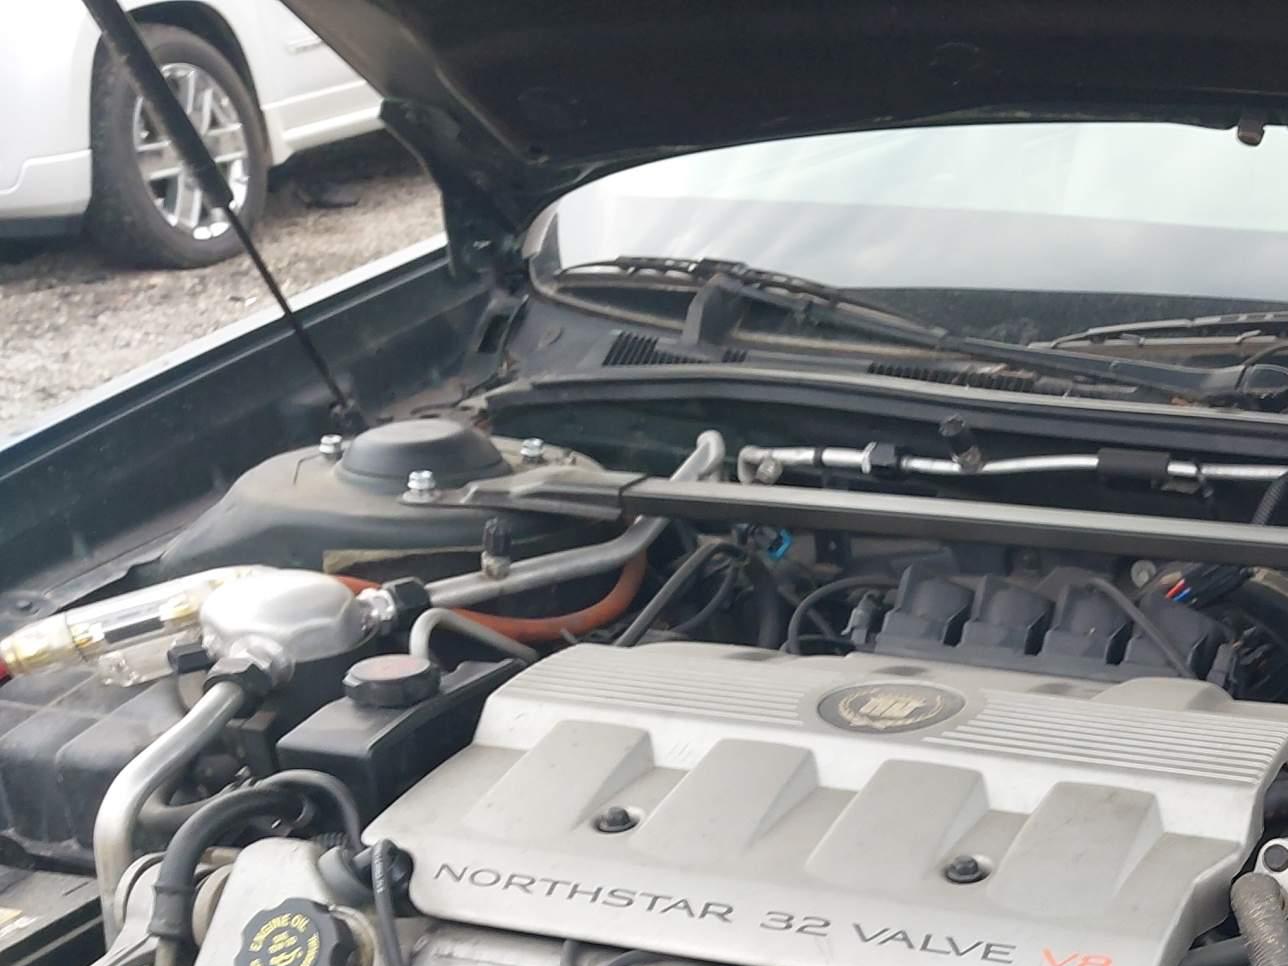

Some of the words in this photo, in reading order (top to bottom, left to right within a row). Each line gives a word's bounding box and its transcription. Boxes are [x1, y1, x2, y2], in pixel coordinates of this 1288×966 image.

[433, 862, 734, 923] NORTHSTAR
[759, 911, 831, 936] 32
[852, 923, 1017, 964] VALVE
